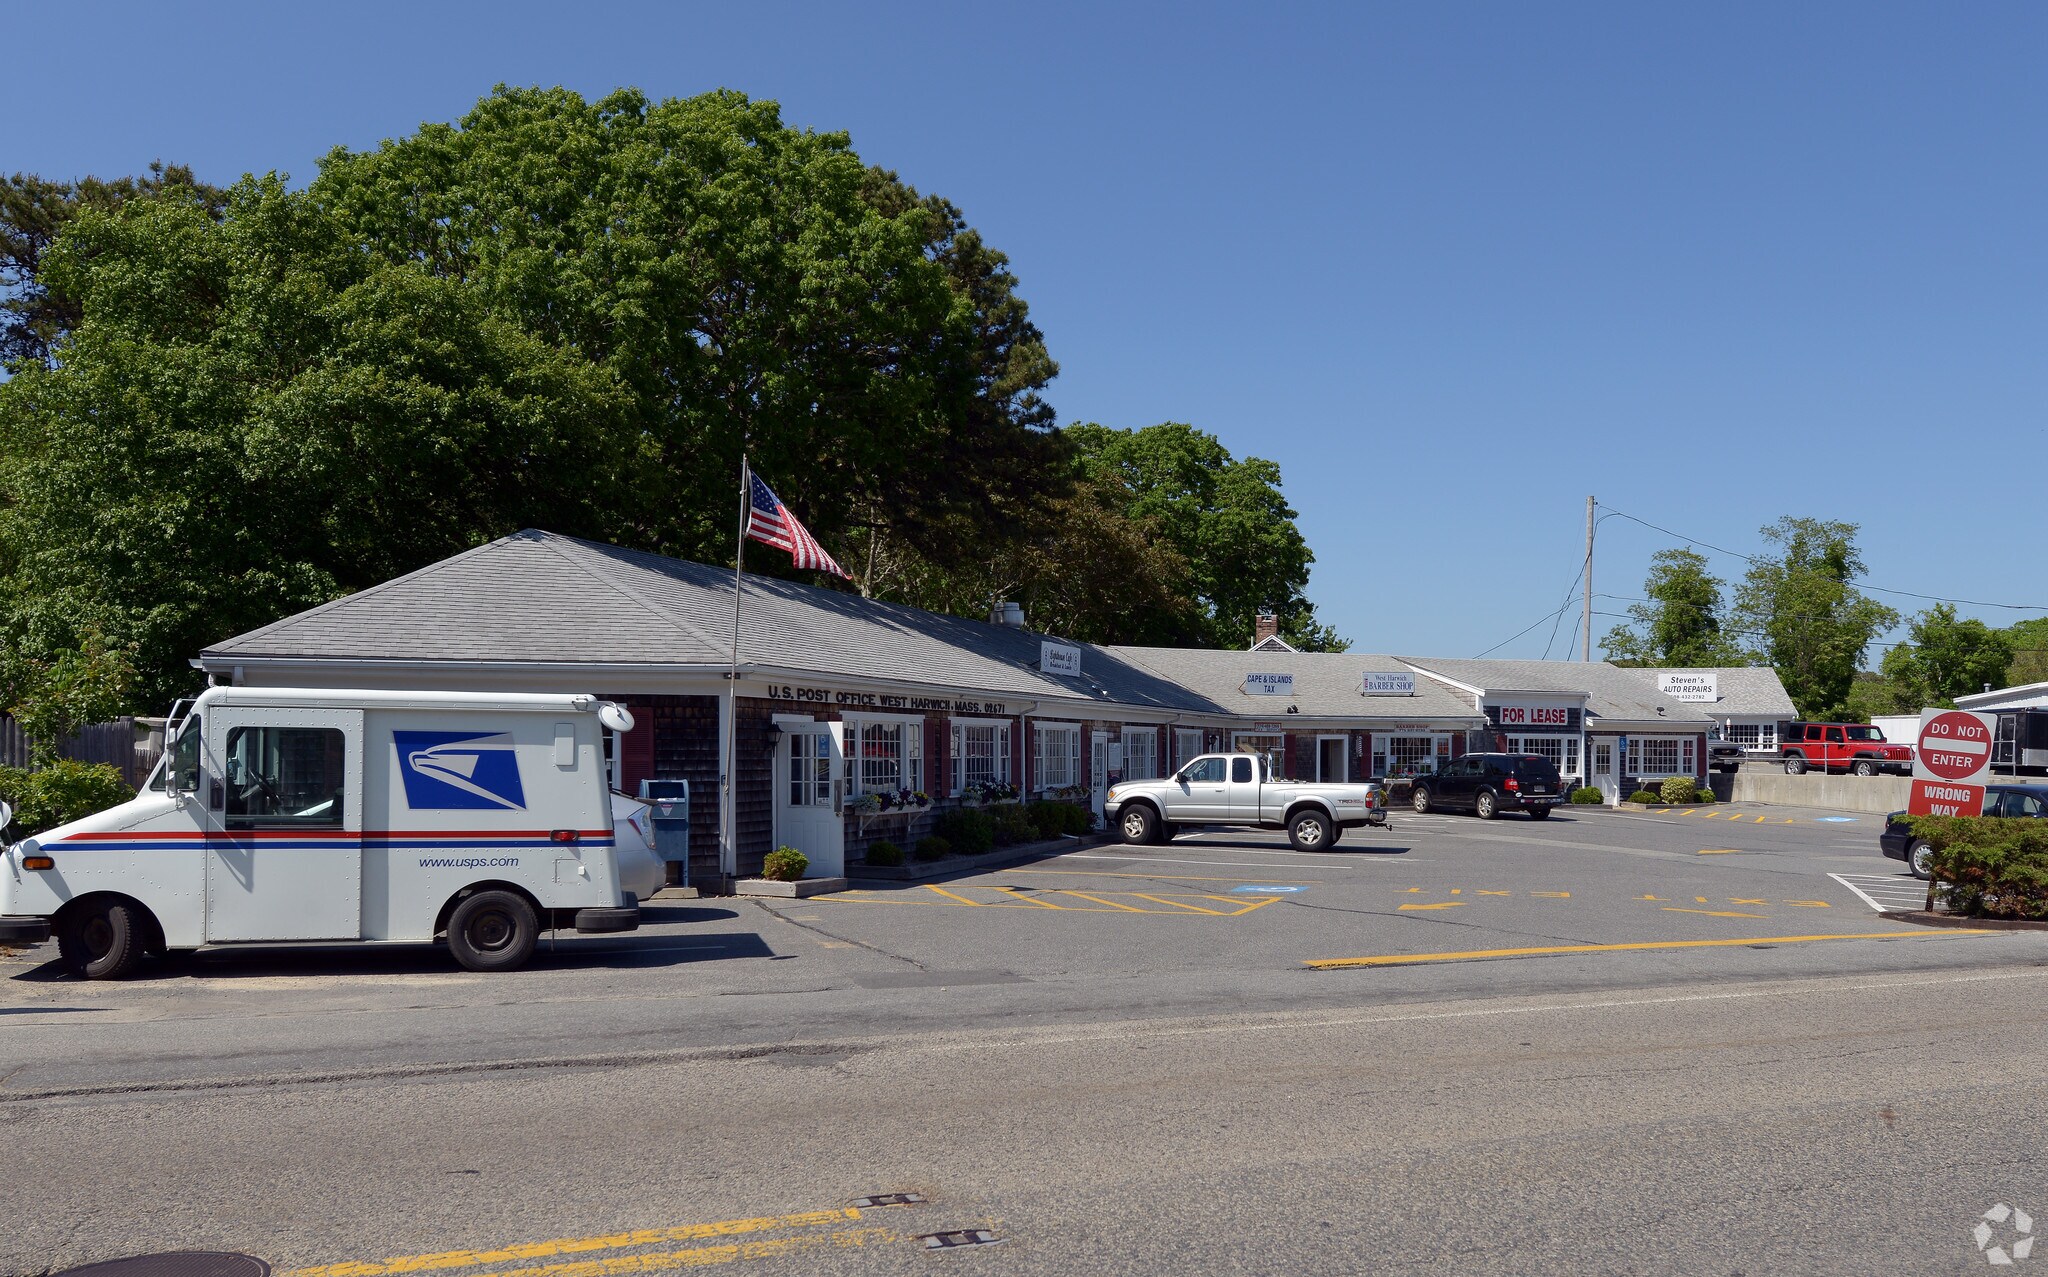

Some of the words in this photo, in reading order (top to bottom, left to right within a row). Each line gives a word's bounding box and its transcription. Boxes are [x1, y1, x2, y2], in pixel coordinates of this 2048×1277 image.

[1247, 675, 1262, 683] CAPE
[1268, 676, 1293, 684] ISLANDS
[1368, 682, 1395, 690] BARBER
[1396, 682, 1414, 690] SHOP
[1670, 676, 1705, 684] Steven's
[1264, 685, 1275, 693] TAX
[1663, 685, 1682, 693] AUTO
[1682, 685, 1713, 693] REPAIRS
[768, 685, 794, 699] U.S.
[796, 688, 831, 702] POST
[836, 692, 876, 705] OFFICE
[879, 695, 907, 708] WEST
[954, 701, 982, 713] MASS.
[984, 703, 1005, 714] 02671
[1502, 707, 1525, 723] FOR
[1530, 708, 1566, 724] LEASE
[1931, 723, 1949, 735] DO
[1957, 725, 1983, 738] NOT
[1932, 753, 1973, 768] ENTER
[1924, 785, 1971, 802] WRONG
[1930, 803, 1960, 817] WAY
[419, 857, 520, 869] www.usps.com
